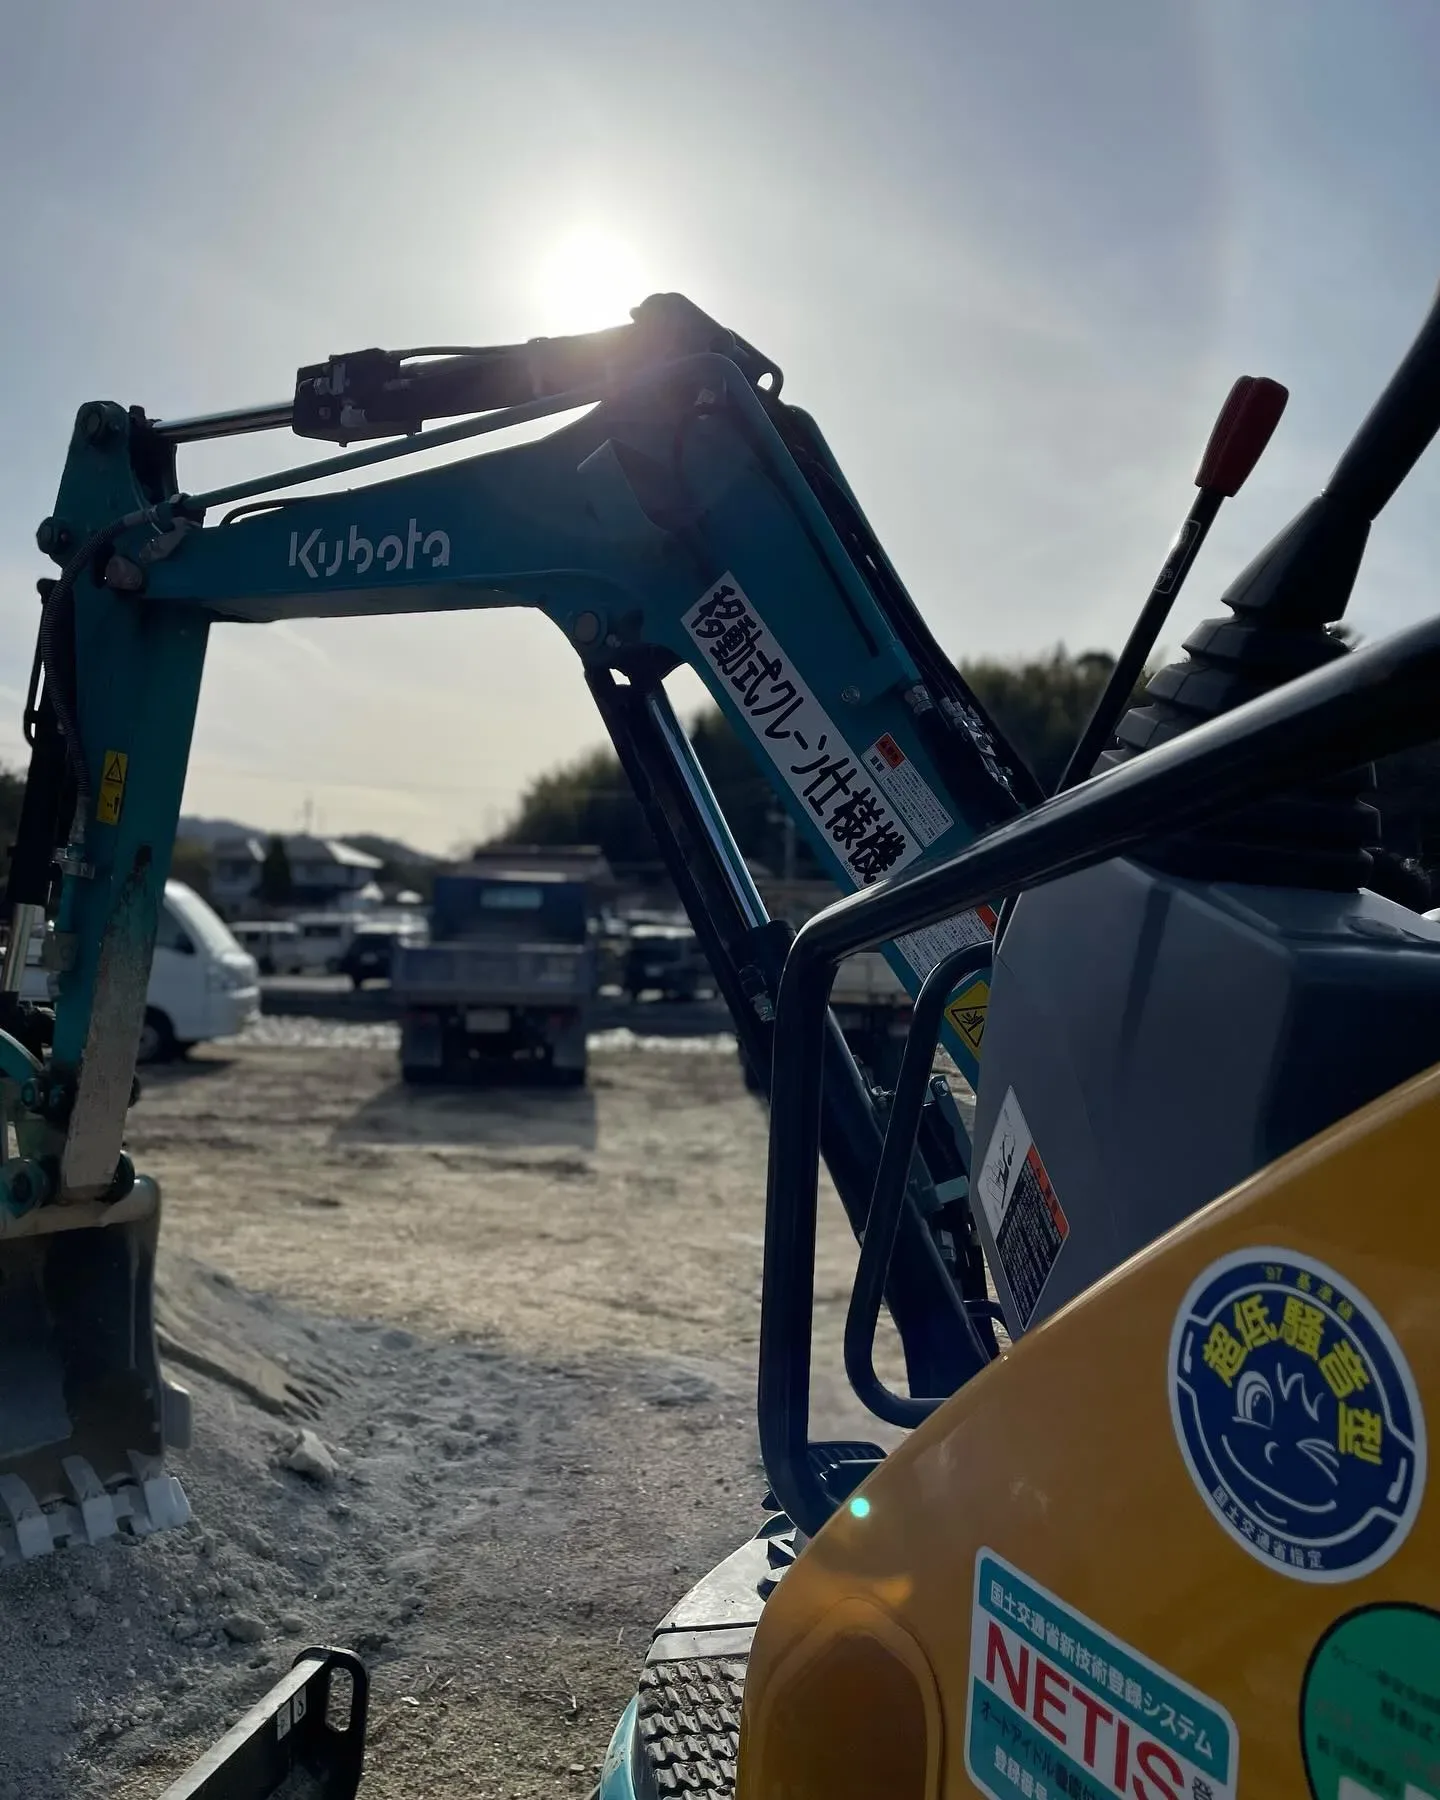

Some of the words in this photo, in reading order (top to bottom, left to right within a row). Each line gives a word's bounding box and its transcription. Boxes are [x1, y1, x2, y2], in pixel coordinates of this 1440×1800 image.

[289, 518, 450, 578] Kubota
[691, 585, 905, 884] 移動式クレーン仕様機
[1203, 1294, 1382, 1465] 超低騒音型
[985, 1619, 1185, 1800] NETIS
[990, 1579, 1213, 1759] 国土交通省新技術登録システム
